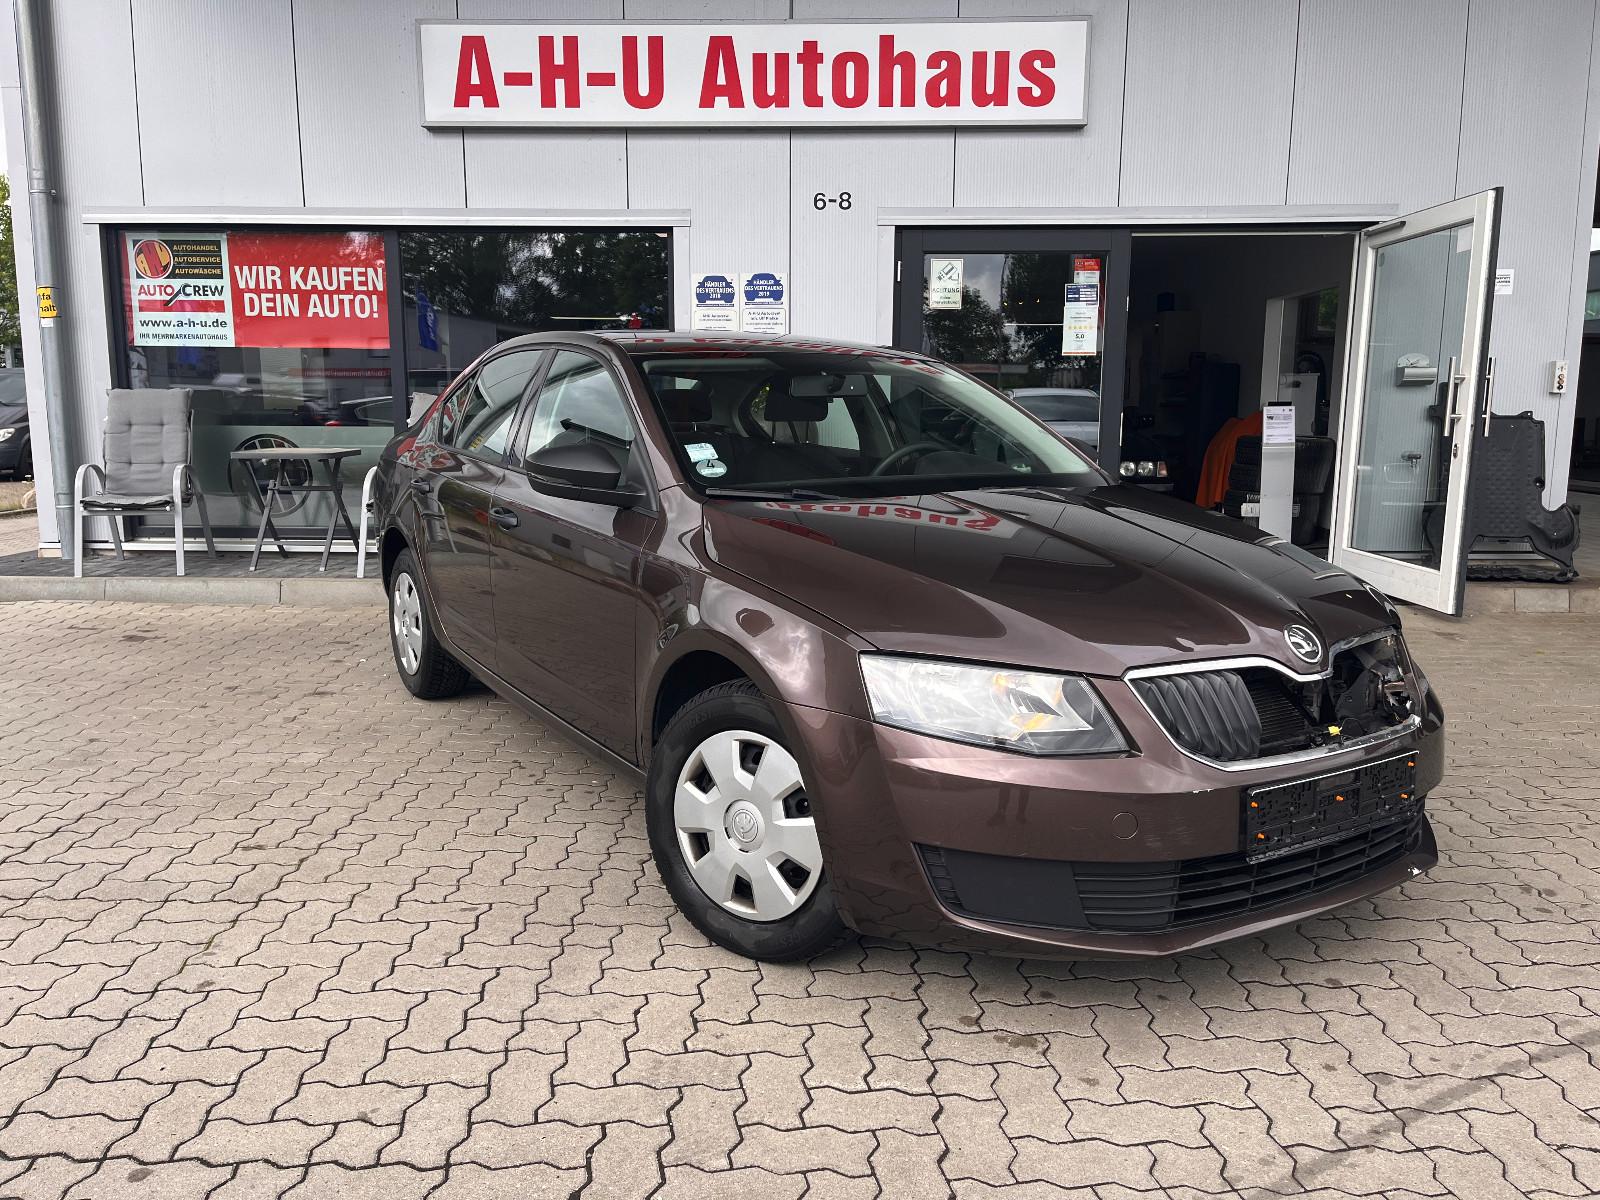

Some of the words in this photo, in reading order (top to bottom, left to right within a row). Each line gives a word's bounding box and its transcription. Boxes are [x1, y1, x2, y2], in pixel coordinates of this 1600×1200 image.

[453, 35, 665, 109] A-H-U
[699, 34, 1056, 108] Autohaus
[813, 191, 852, 210] 6-8
[175, 267, 222, 275] AUTOWÄSCHE
[234, 265, 283, 290] WIR
[289, 266, 384, 291] KAUFEN
[138, 284, 175, 297] AUTO
[181, 283, 224, 297] CREW
[243, 292, 300, 317] DEIN
[307, 293, 379, 318] AUTO!
[139, 318, 228, 328] www.a-h-u.de
[139, 332, 150, 340] IHR
[152, 332, 228, 341] MEHRMARKENAUTOHAUS
